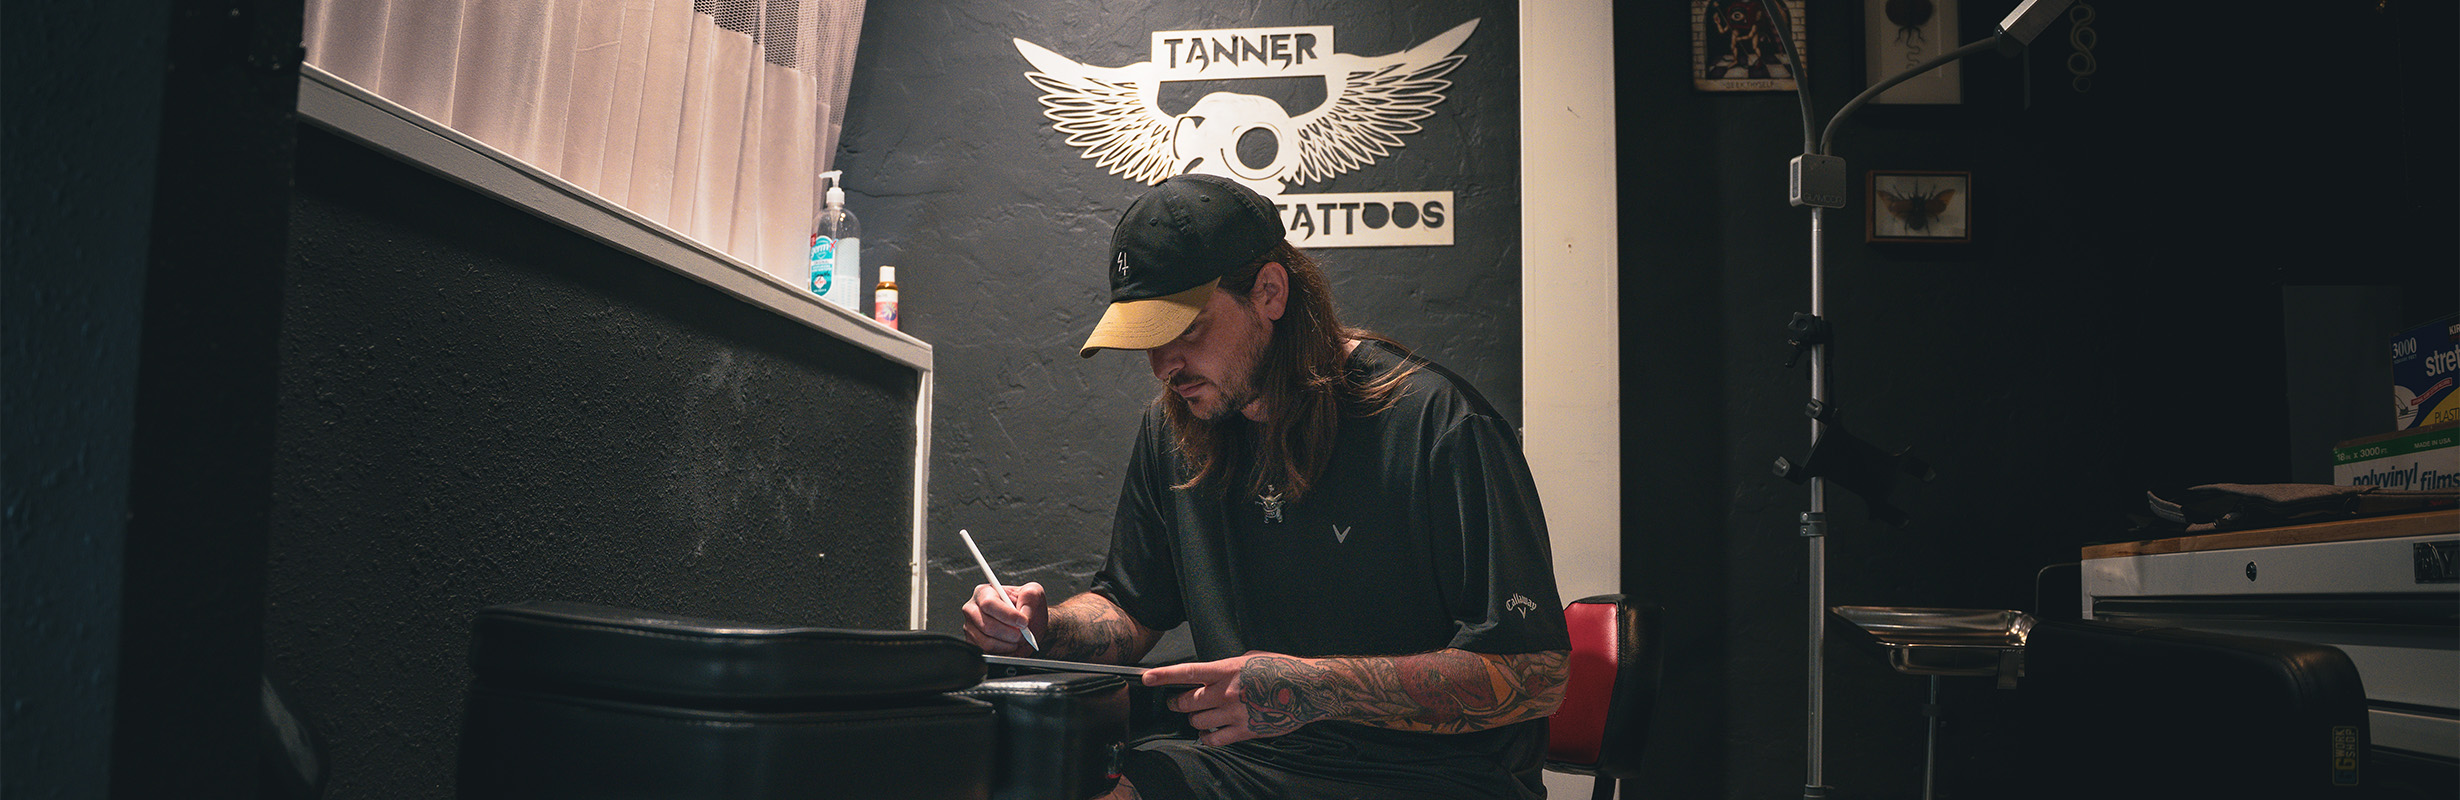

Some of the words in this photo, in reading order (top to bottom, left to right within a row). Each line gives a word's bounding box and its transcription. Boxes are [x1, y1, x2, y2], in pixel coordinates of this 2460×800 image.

[1163, 33, 1318, 73] TANNER
[1275, 200, 1445, 241] ATTOOS
[2392, 337, 2417, 359] 3000
[2360, 446, 2380, 458] 3000
[2414, 440, 2431, 448] MADE
[2439, 437, 2451, 445] USA
[1506, 593, 1537, 611] Callaway
